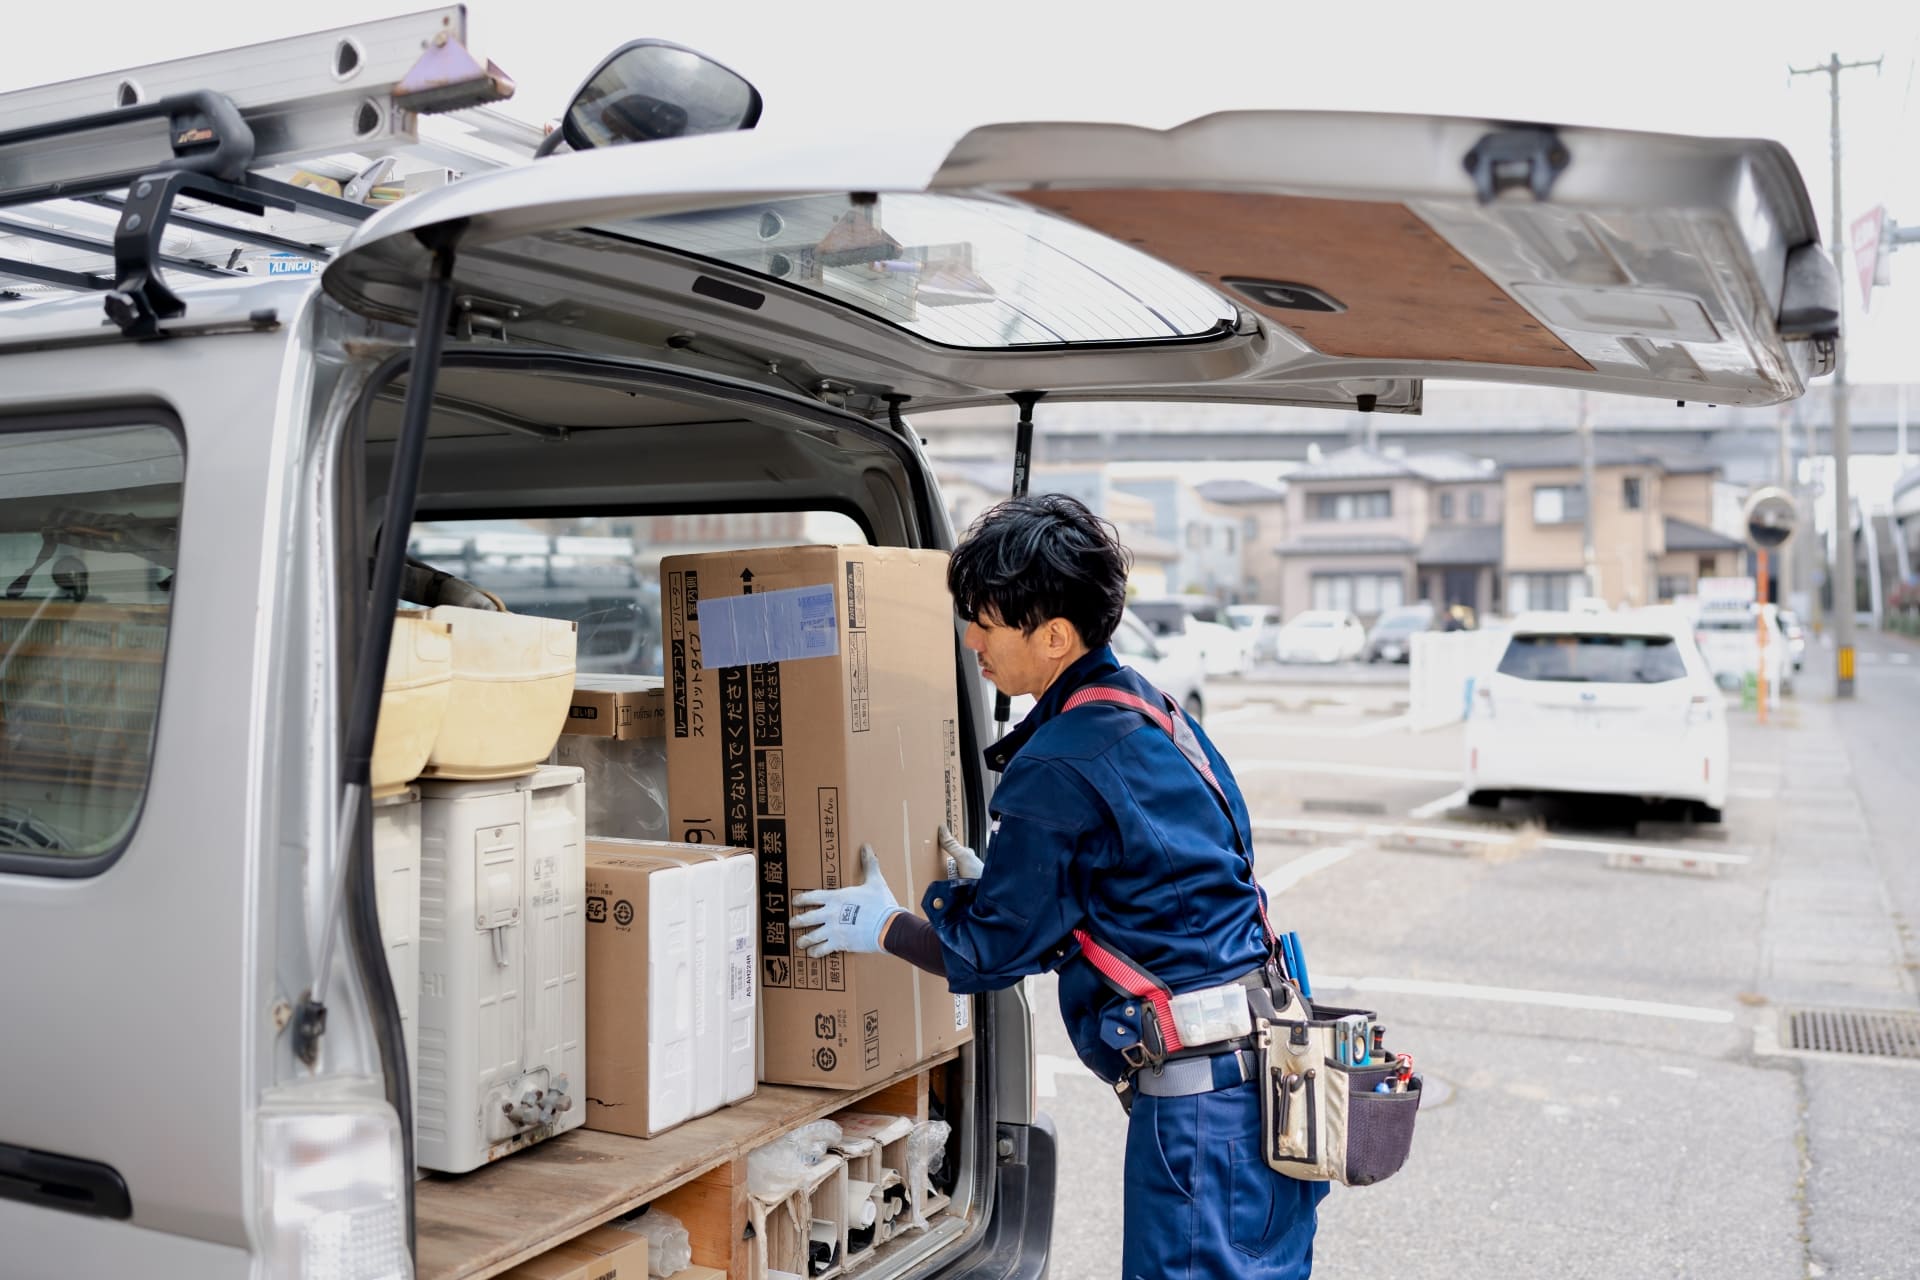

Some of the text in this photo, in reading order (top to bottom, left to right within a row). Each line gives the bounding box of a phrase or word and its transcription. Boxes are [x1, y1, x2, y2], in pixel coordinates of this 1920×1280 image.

[672, 575, 682, 637] インバーター
[672, 641, 686, 735] ルームエアコン
[689, 631, 704, 737] スプリットタイプ
[753, 663, 767, 738] この面を上に
[763, 831, 786, 945] 踏付厳禁
[823, 796, 837, 888] 梱していません。
